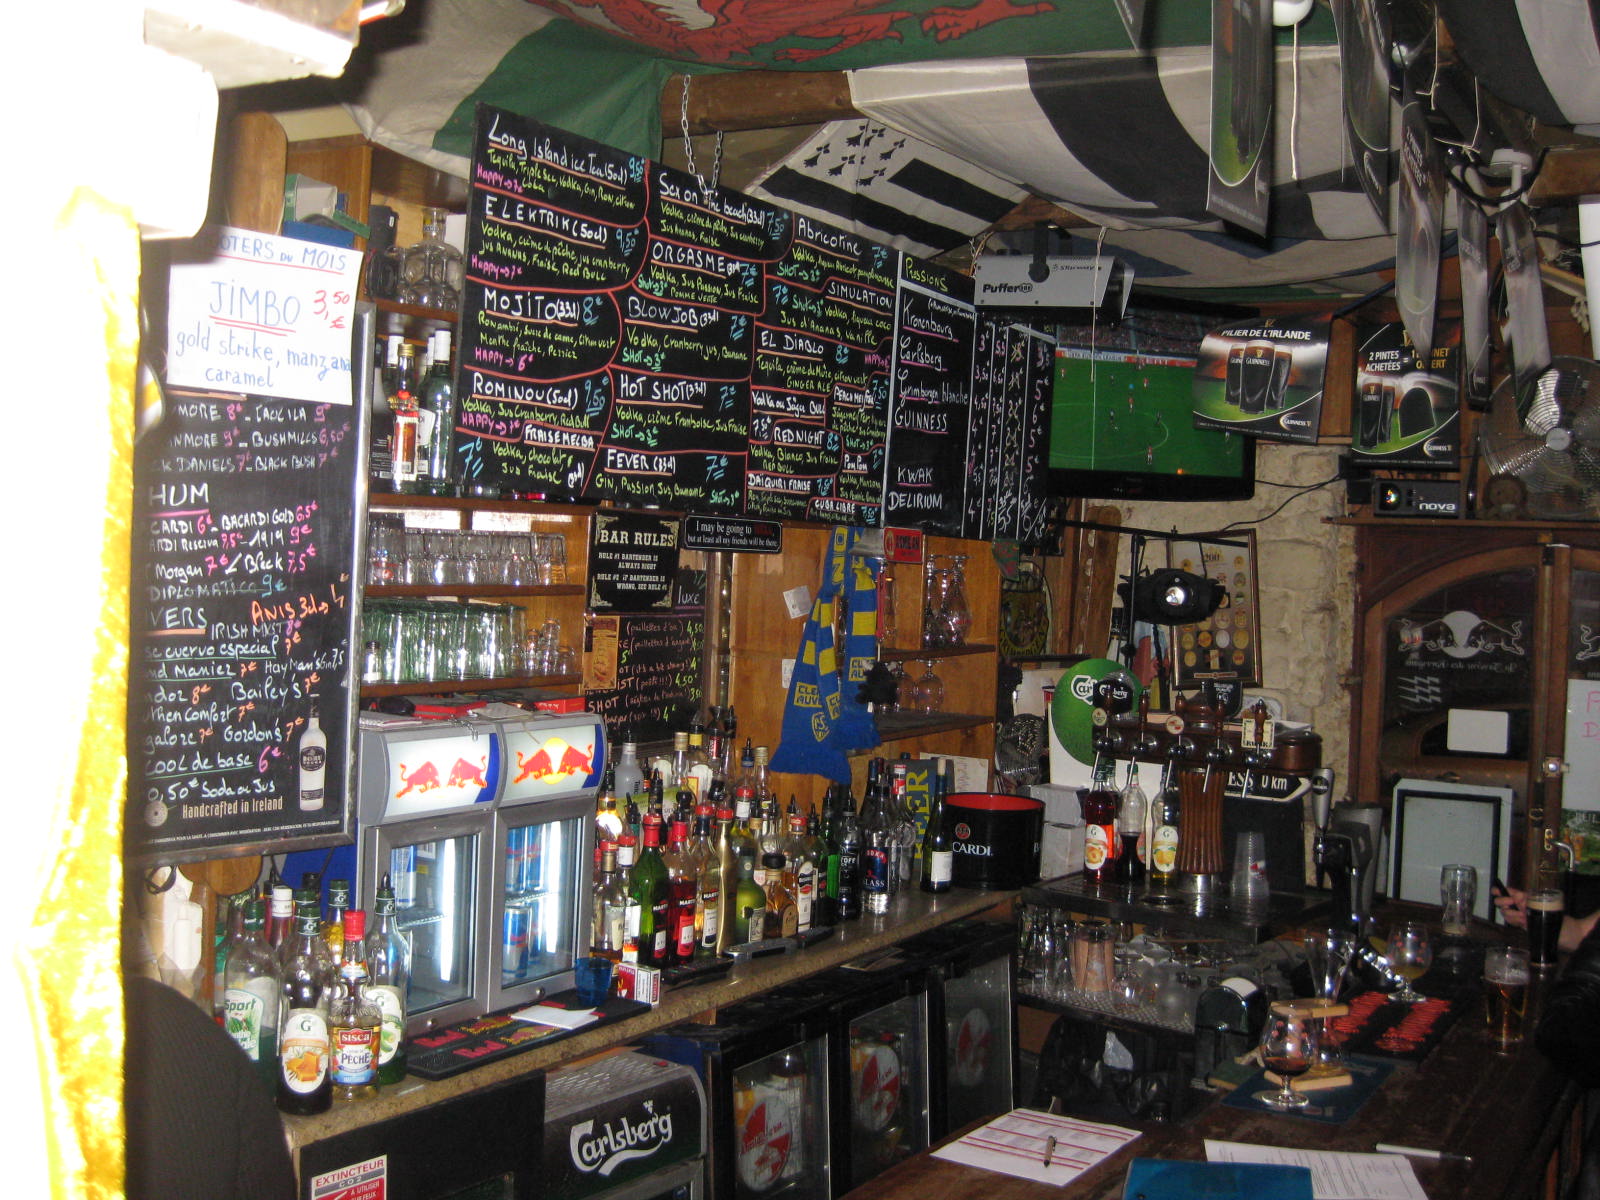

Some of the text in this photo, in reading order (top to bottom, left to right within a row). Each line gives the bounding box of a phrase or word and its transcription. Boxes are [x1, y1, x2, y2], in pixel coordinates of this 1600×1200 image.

[488, 113, 527, 160] Long
[533, 139, 567, 166] Island
[659, 172, 680, 198] Sex
[798, 217, 863, 256] Abricotine
[302, 248, 346, 270] MOIS
[652, 242, 726, 272] ORGASME
[828, 281, 893, 309] SIMULATION
[983, 283, 1019, 293] Puffer
[210, 280, 301, 326] JIMBO
[628, 296, 671, 318] BLOW
[903, 294, 952, 341] Kronenbourg
[175, 322, 210, 356] gold
[761, 330, 776, 347] EL
[1221, 329, 1311, 340] PILIER DE L'IRLANDE
[901, 342, 942, 371] Carlsberg
[1369, 350, 1399, 360] 2 PINTES
[1365, 361, 1401, 371] ACHETÉES
[205, 366, 273, 387] caramel
[651, 381, 686, 402] SHOT
[895, 407, 947, 431] GUINNESS
[607, 449, 649, 470] FEVER
[898, 467, 933, 483] KWAK
[888, 491, 942, 510] DELIRIUM
[1419, 503, 1456, 511] nova
[221, 511, 270, 529] BACARDI
[701, 524, 715, 534] may
[716, 522, 724, 532] be
[726, 523, 744, 536] going
[745, 526, 752, 534] to
[600, 529, 674, 547] BAR RULES
[687, 534, 696, 543] but
[732, 536, 748, 544] friends
[749, 537, 758, 545] will
[156, 563, 202, 583] Morgan
[618, 561, 640, 569] ALWAYS
[678, 586, 699, 605] luxe
[166, 646, 214, 658] cuervo
[220, 635, 278, 659] especial
[231, 674, 302, 707] Bailey's
[589, 696, 619, 713] SHOT
[224, 718, 282, 742] Gordon's
[201, 778, 235, 798] Soda
[1271, 776, 1287, 790] km
[182, 796, 283, 819] Handcrafted in Ireland
[953, 841, 992, 857] CARDI
[225, 999, 256, 1013] Sport
[300, 1019, 312, 1032] G
[570, 1110, 673, 1173] Carlsberg
[316, 1159, 384, 1187] EXTINCTEUR
